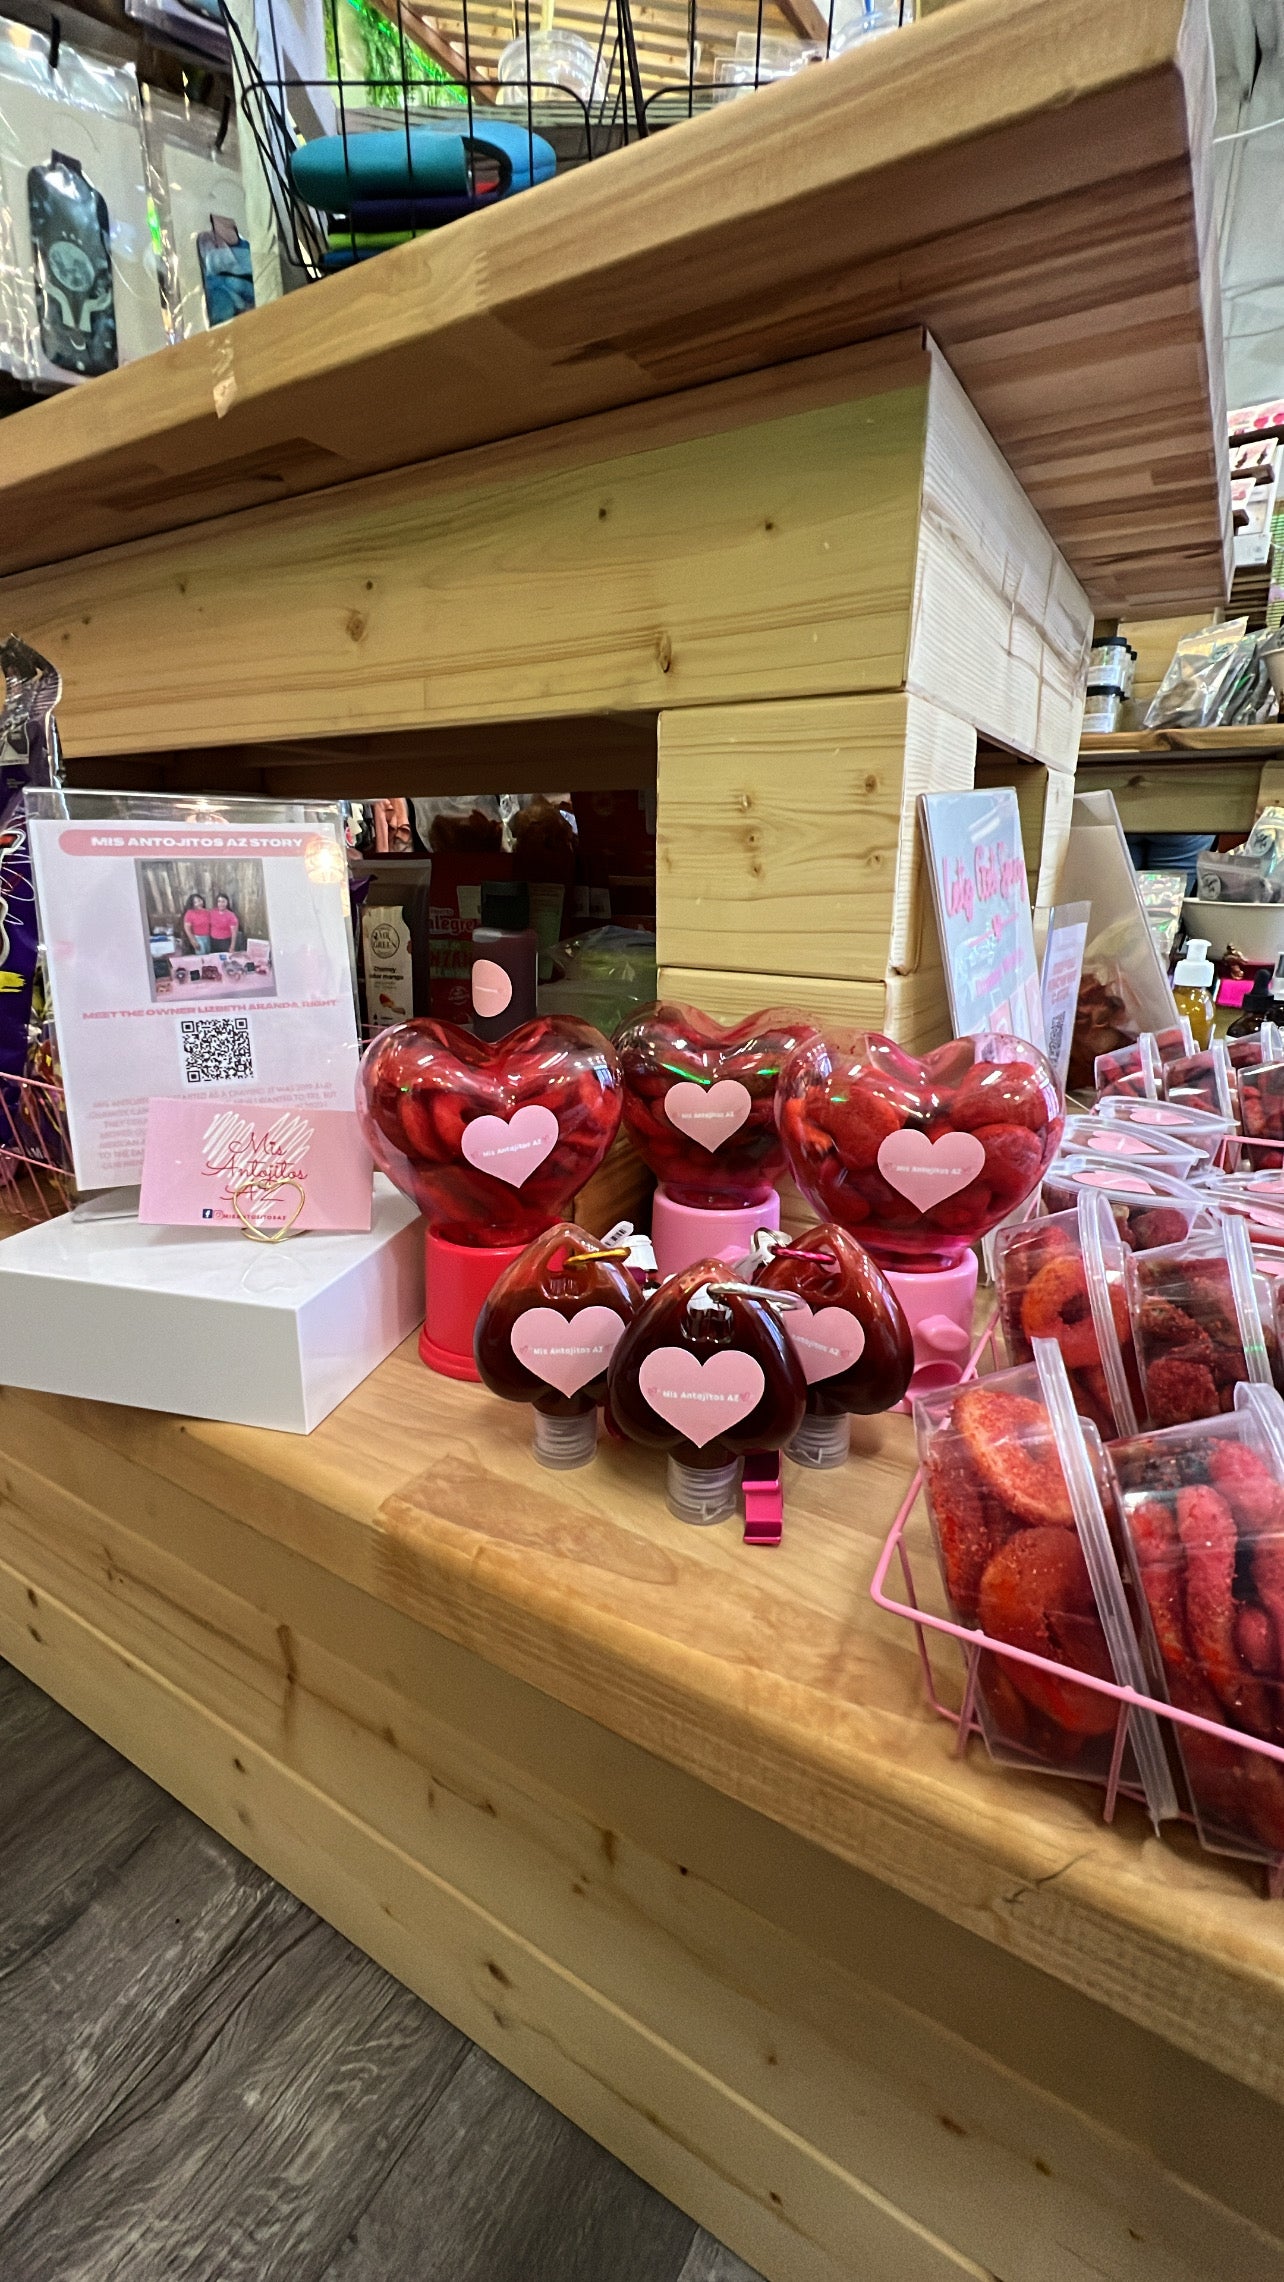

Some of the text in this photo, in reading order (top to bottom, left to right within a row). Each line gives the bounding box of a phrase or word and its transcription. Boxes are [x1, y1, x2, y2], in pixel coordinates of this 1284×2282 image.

[91, 837, 303, 848] MIS ANTOJITOS AZ STORY
[82, 1011, 117, 1019] MEET
[146, 1007, 195, 1016] OWNER
[198, 1004, 247, 1013] LIZBETH
[228, 1131, 287, 1156] Mis
[201, 1154, 308, 1184] Antojitos
[533, 1345, 603, 1356] Mis Antojitos AZ
[662, 1390, 739, 1402] Mis Antojitos AZ
